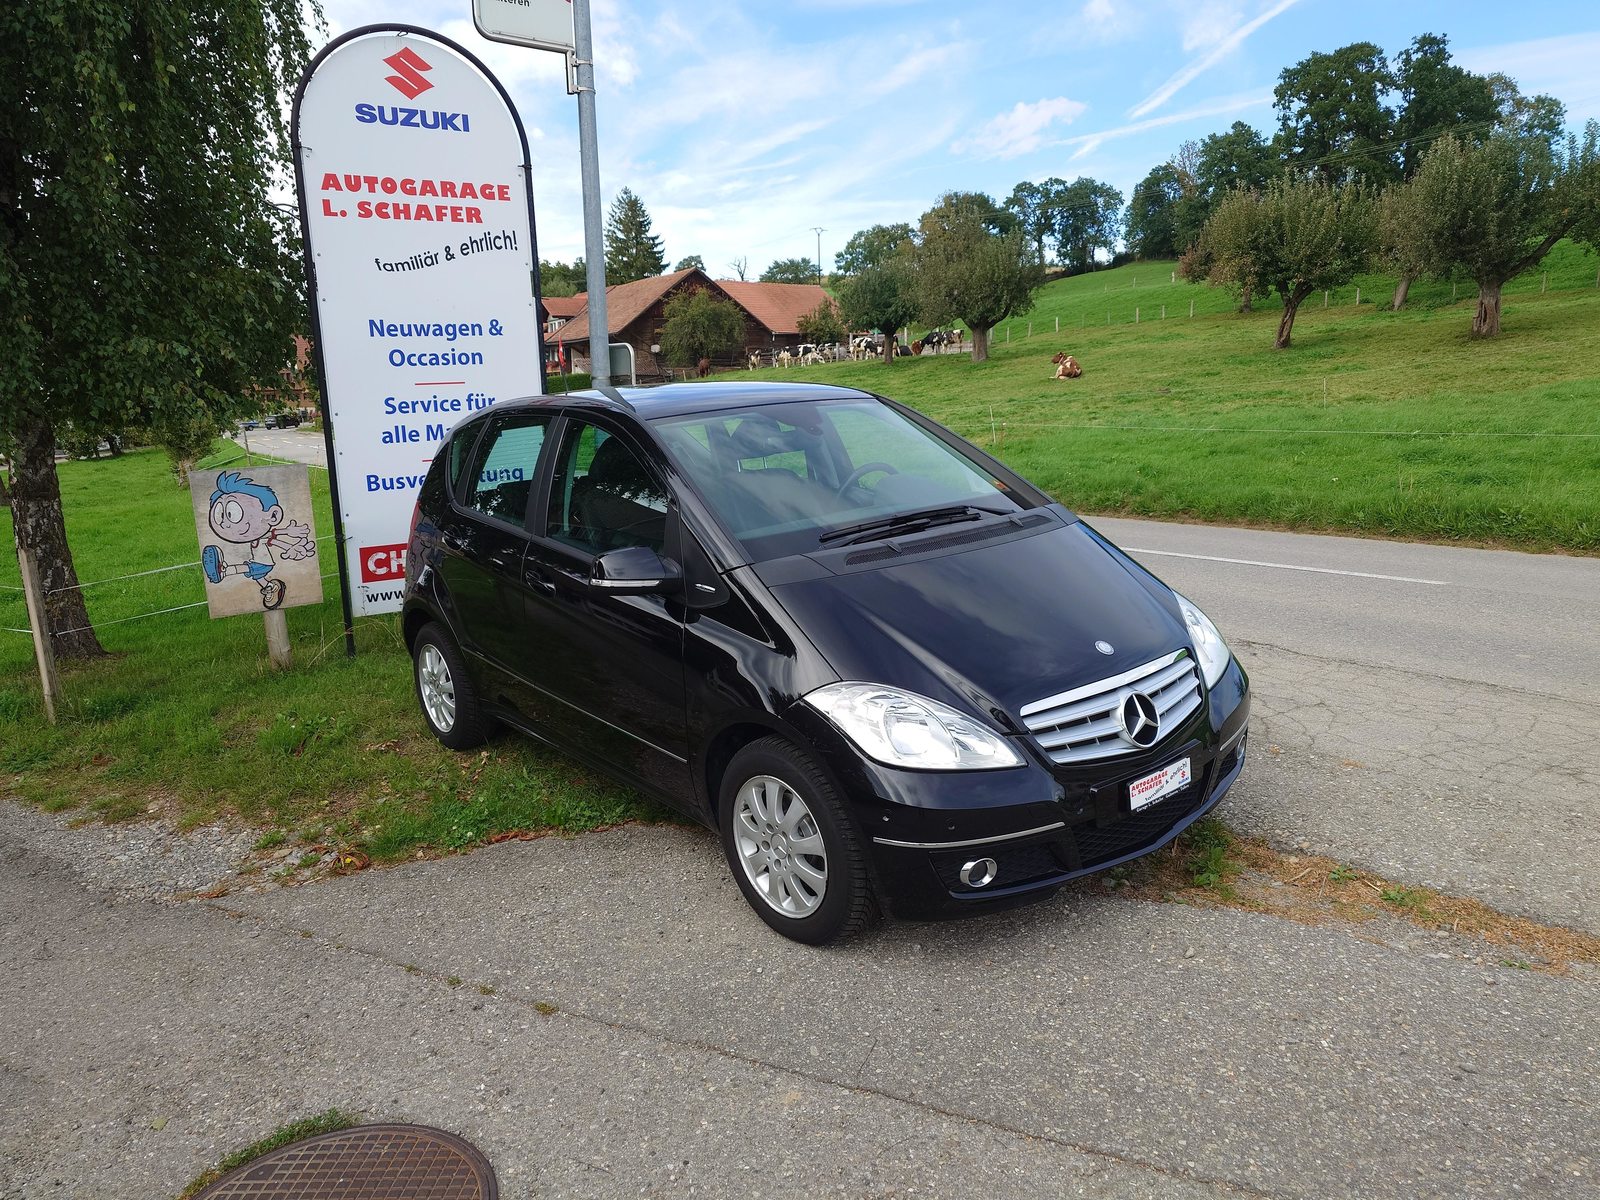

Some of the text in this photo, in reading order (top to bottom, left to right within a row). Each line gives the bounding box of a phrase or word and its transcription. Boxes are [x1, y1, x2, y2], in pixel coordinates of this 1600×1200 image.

[355, 103, 470, 132] SUZUKI
[321, 173, 511, 201] AUTOGARAGE
[322, 199, 483, 224] L. SCHAFER
[375, 230, 518, 272] familiär & ehrlich!
[368, 319, 503, 342] Neuwagen &
[388, 347, 484, 367] Occasion
[384, 392, 495, 415] Service für
[381, 425, 420, 444] alle
